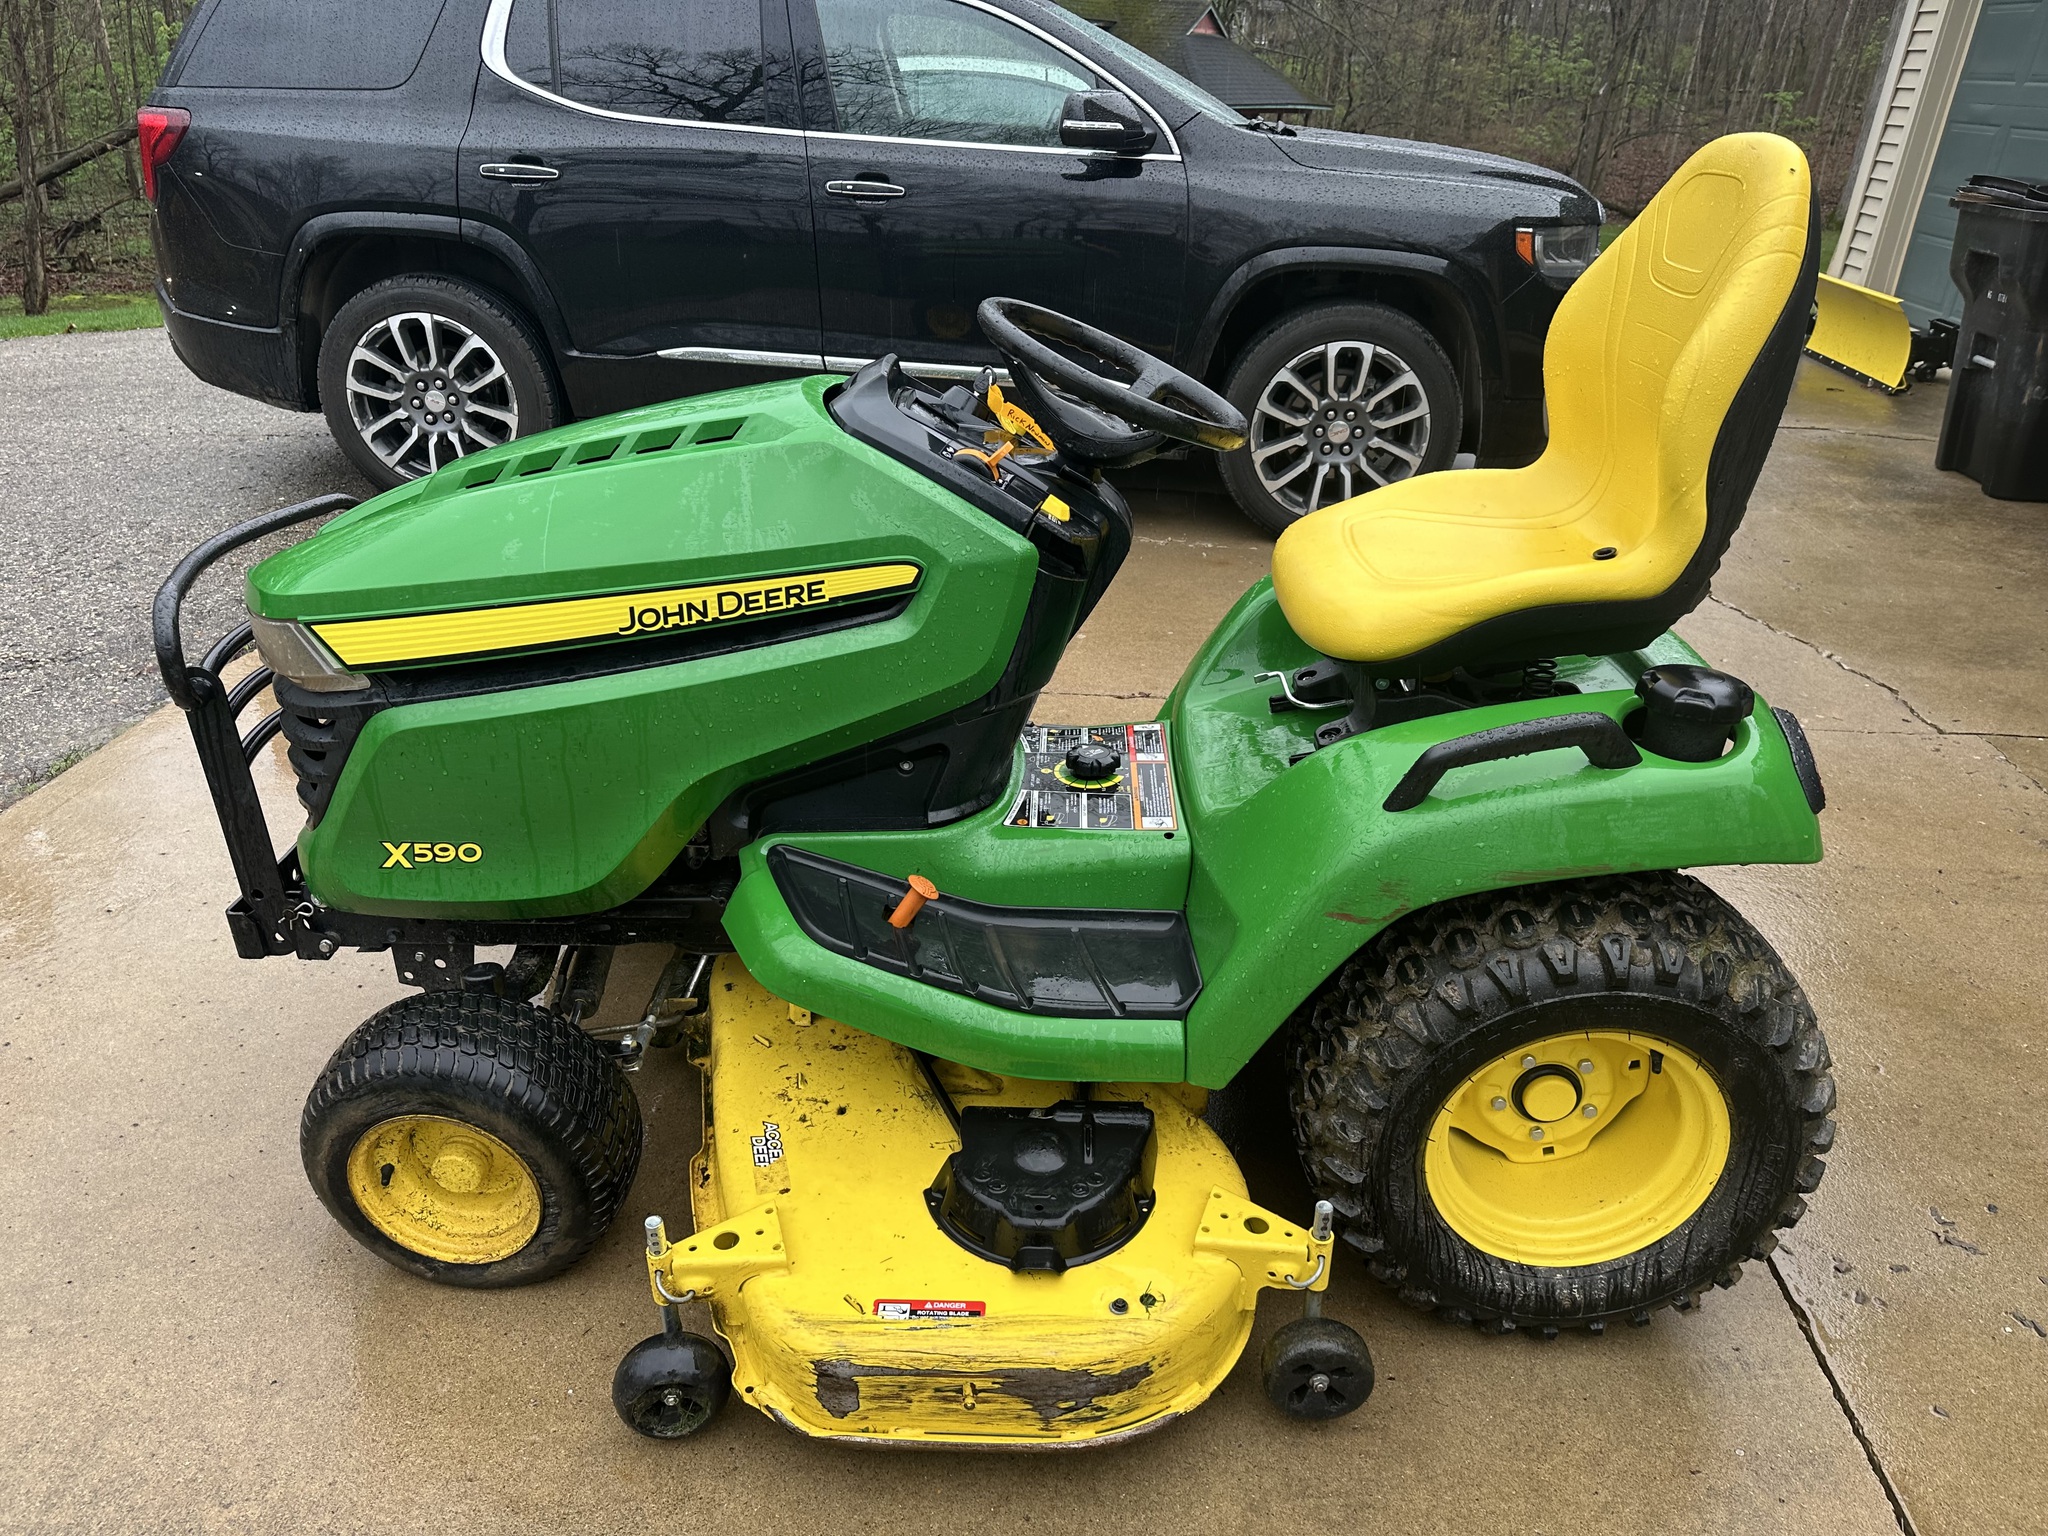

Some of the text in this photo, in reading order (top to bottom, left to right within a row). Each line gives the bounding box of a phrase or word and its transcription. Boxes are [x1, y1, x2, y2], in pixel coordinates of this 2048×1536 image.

[618, 579, 826, 632] JOHN DEERE
[378, 841, 483, 869] X590
